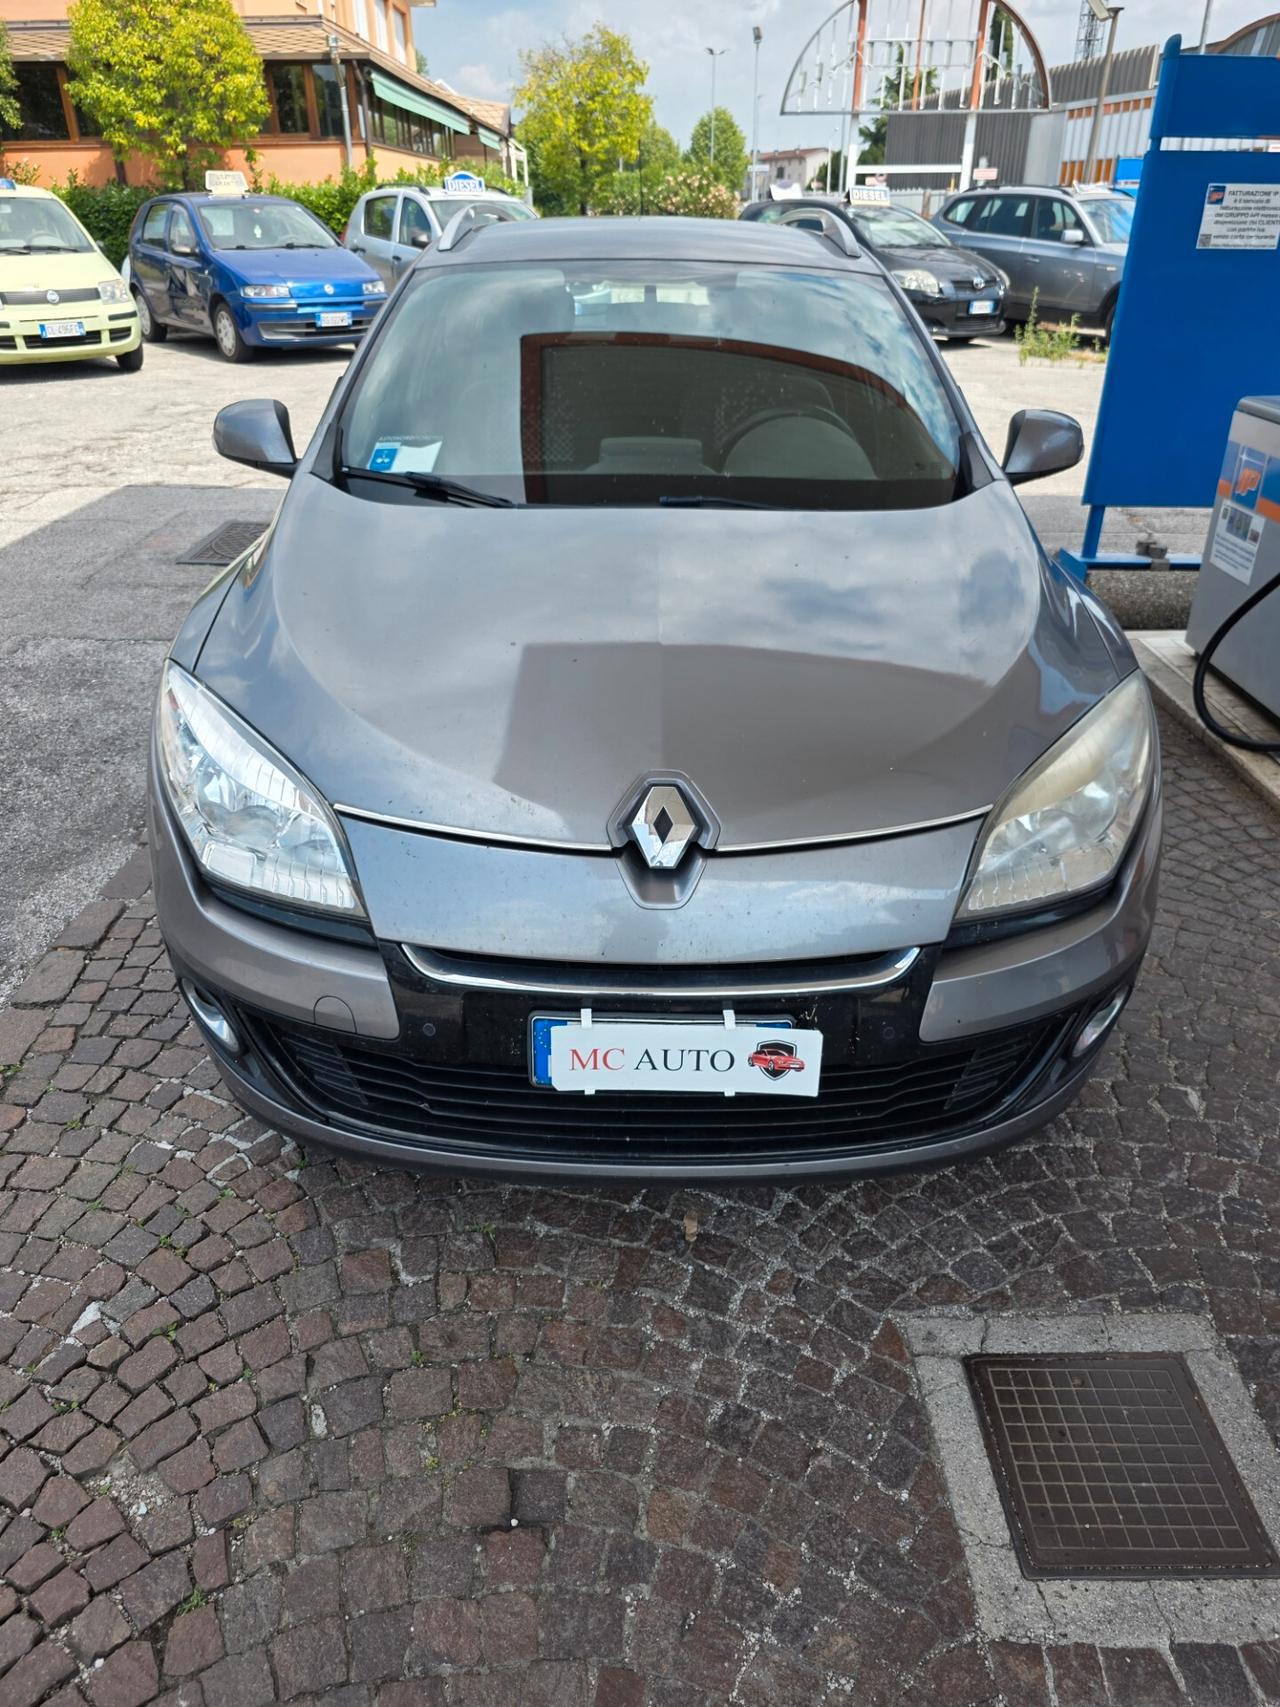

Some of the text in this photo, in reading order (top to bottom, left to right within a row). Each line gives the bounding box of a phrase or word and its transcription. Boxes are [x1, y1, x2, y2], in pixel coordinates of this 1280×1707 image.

[447, 179, 484, 192] DIESEL
[852, 190, 887, 201] DIESEL
[569, 1048, 735, 1072] MC AUTO
